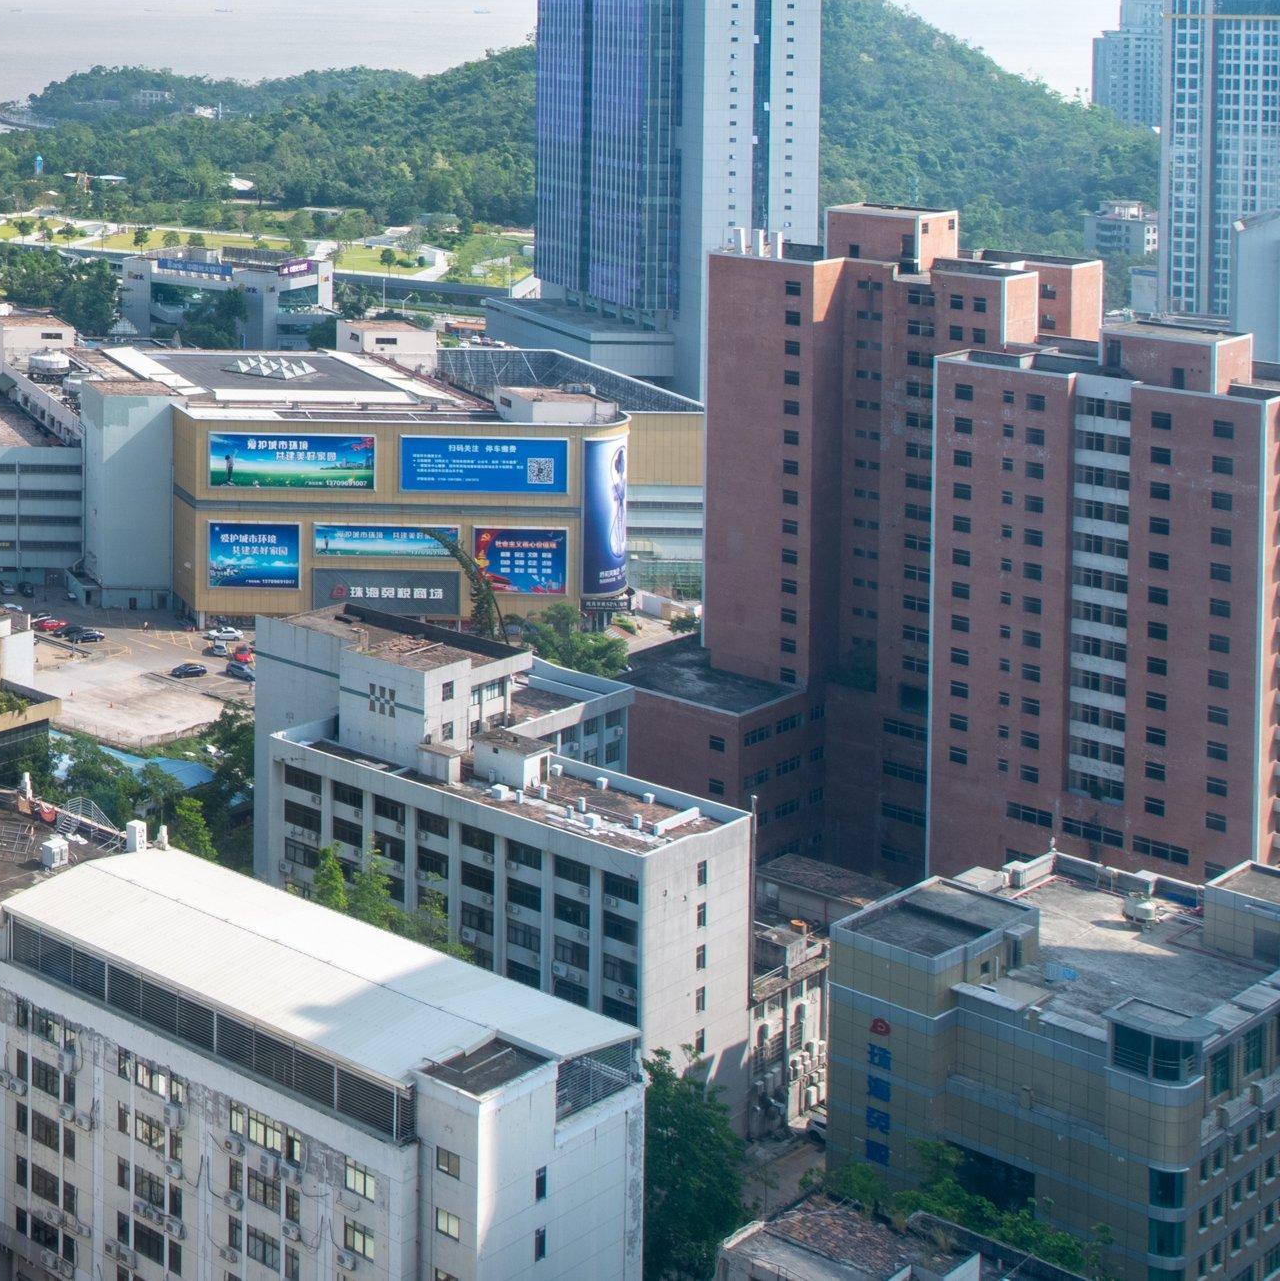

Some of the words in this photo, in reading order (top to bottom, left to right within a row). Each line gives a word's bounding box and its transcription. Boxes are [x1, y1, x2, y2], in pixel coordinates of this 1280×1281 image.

[247, 438, 308, 450] 爱护城市环境
[448, 445, 479, 453] 扫码关注
[275, 451, 337, 462] 共建美好家园
[220, 533, 277, 544] 爱护城市环境
[335, 530, 384, 539] 爱护城市环境
[232, 545, 288, 556] 共建美好家园
[349, 586, 444, 599] 珠海免税商场
